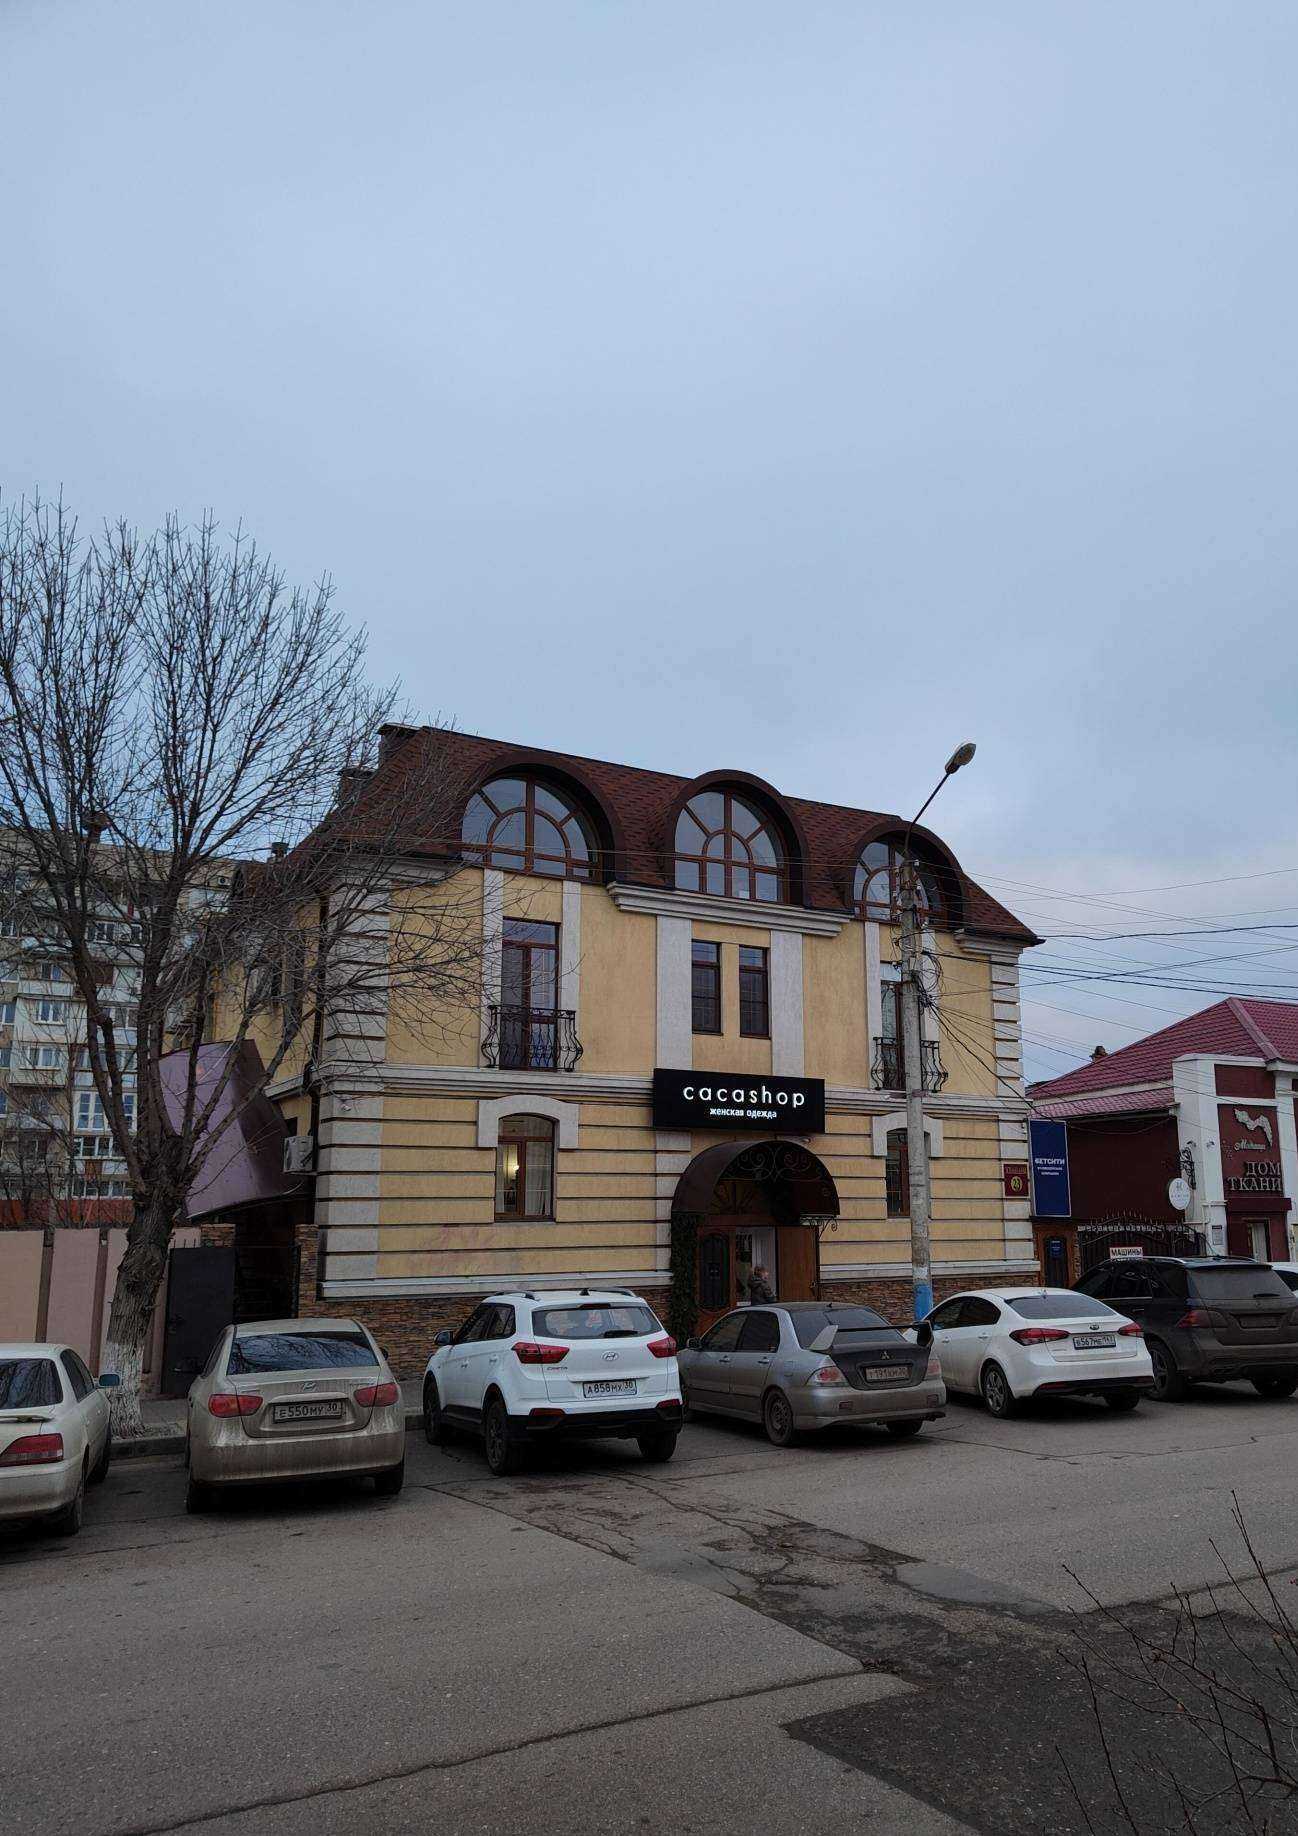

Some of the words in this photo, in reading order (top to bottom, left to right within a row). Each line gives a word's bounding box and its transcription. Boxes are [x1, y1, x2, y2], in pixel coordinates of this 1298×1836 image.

[682, 1085, 805, 1109] cacashop
[709, 1108, 744, 1117] женская
[746, 1109, 777, 1119] одежда
[1246, 1161, 1281, 1177] ДОМ
[1227, 1177, 1283, 1191] ТКАНИ
[1110, 1248, 1142, 1257] МАШИНЫ
